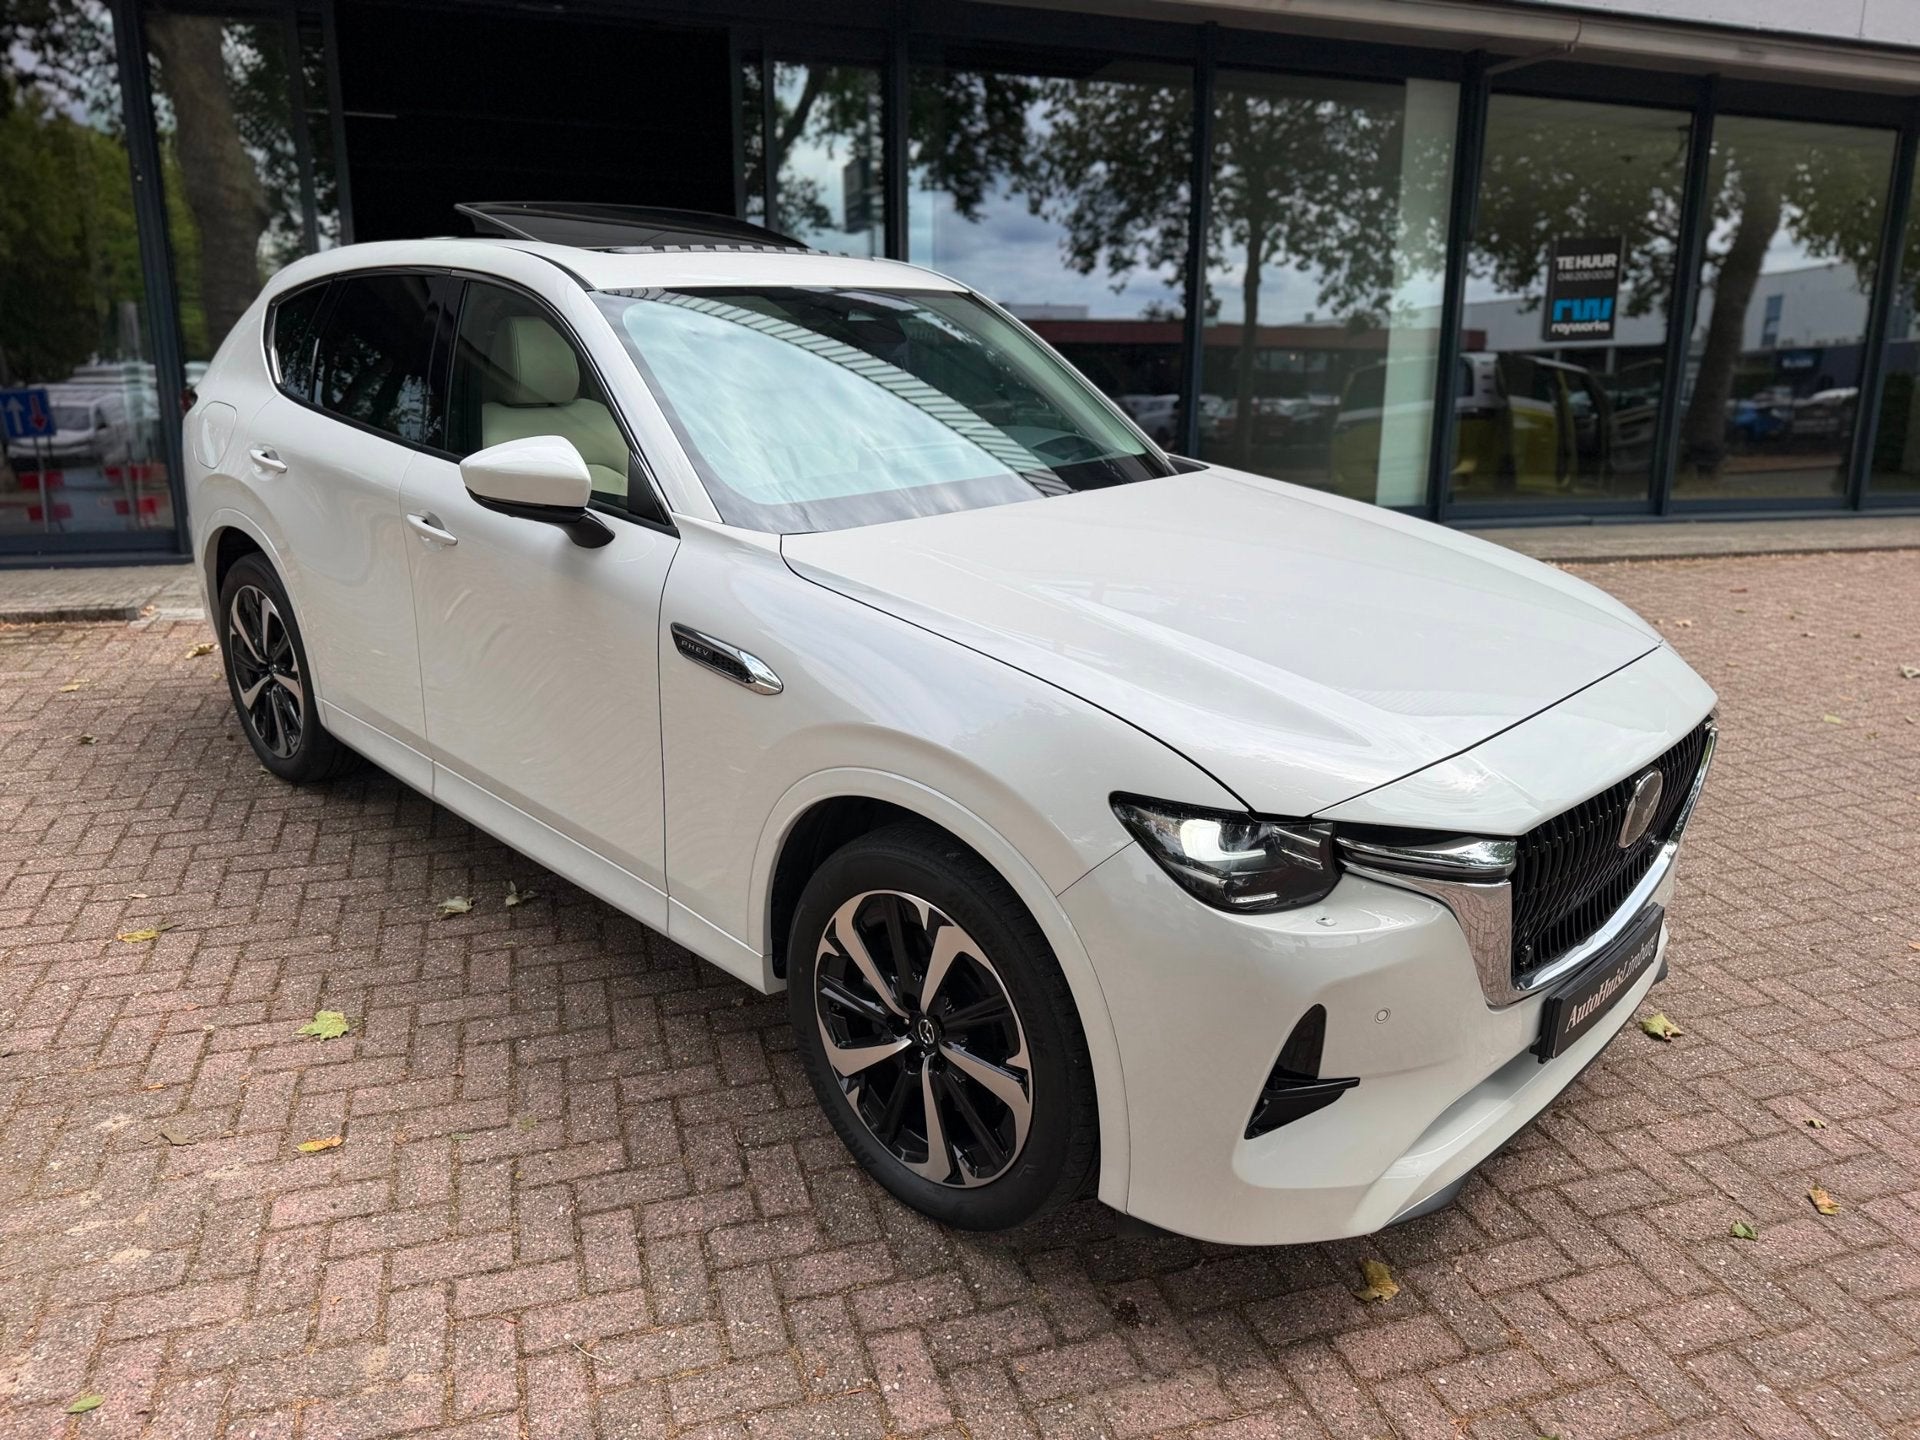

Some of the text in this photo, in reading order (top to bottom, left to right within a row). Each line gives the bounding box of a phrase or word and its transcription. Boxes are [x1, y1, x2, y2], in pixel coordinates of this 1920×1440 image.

[1556, 253, 1617, 270] TE HUUR
[681, 640, 709, 656] PHEV
